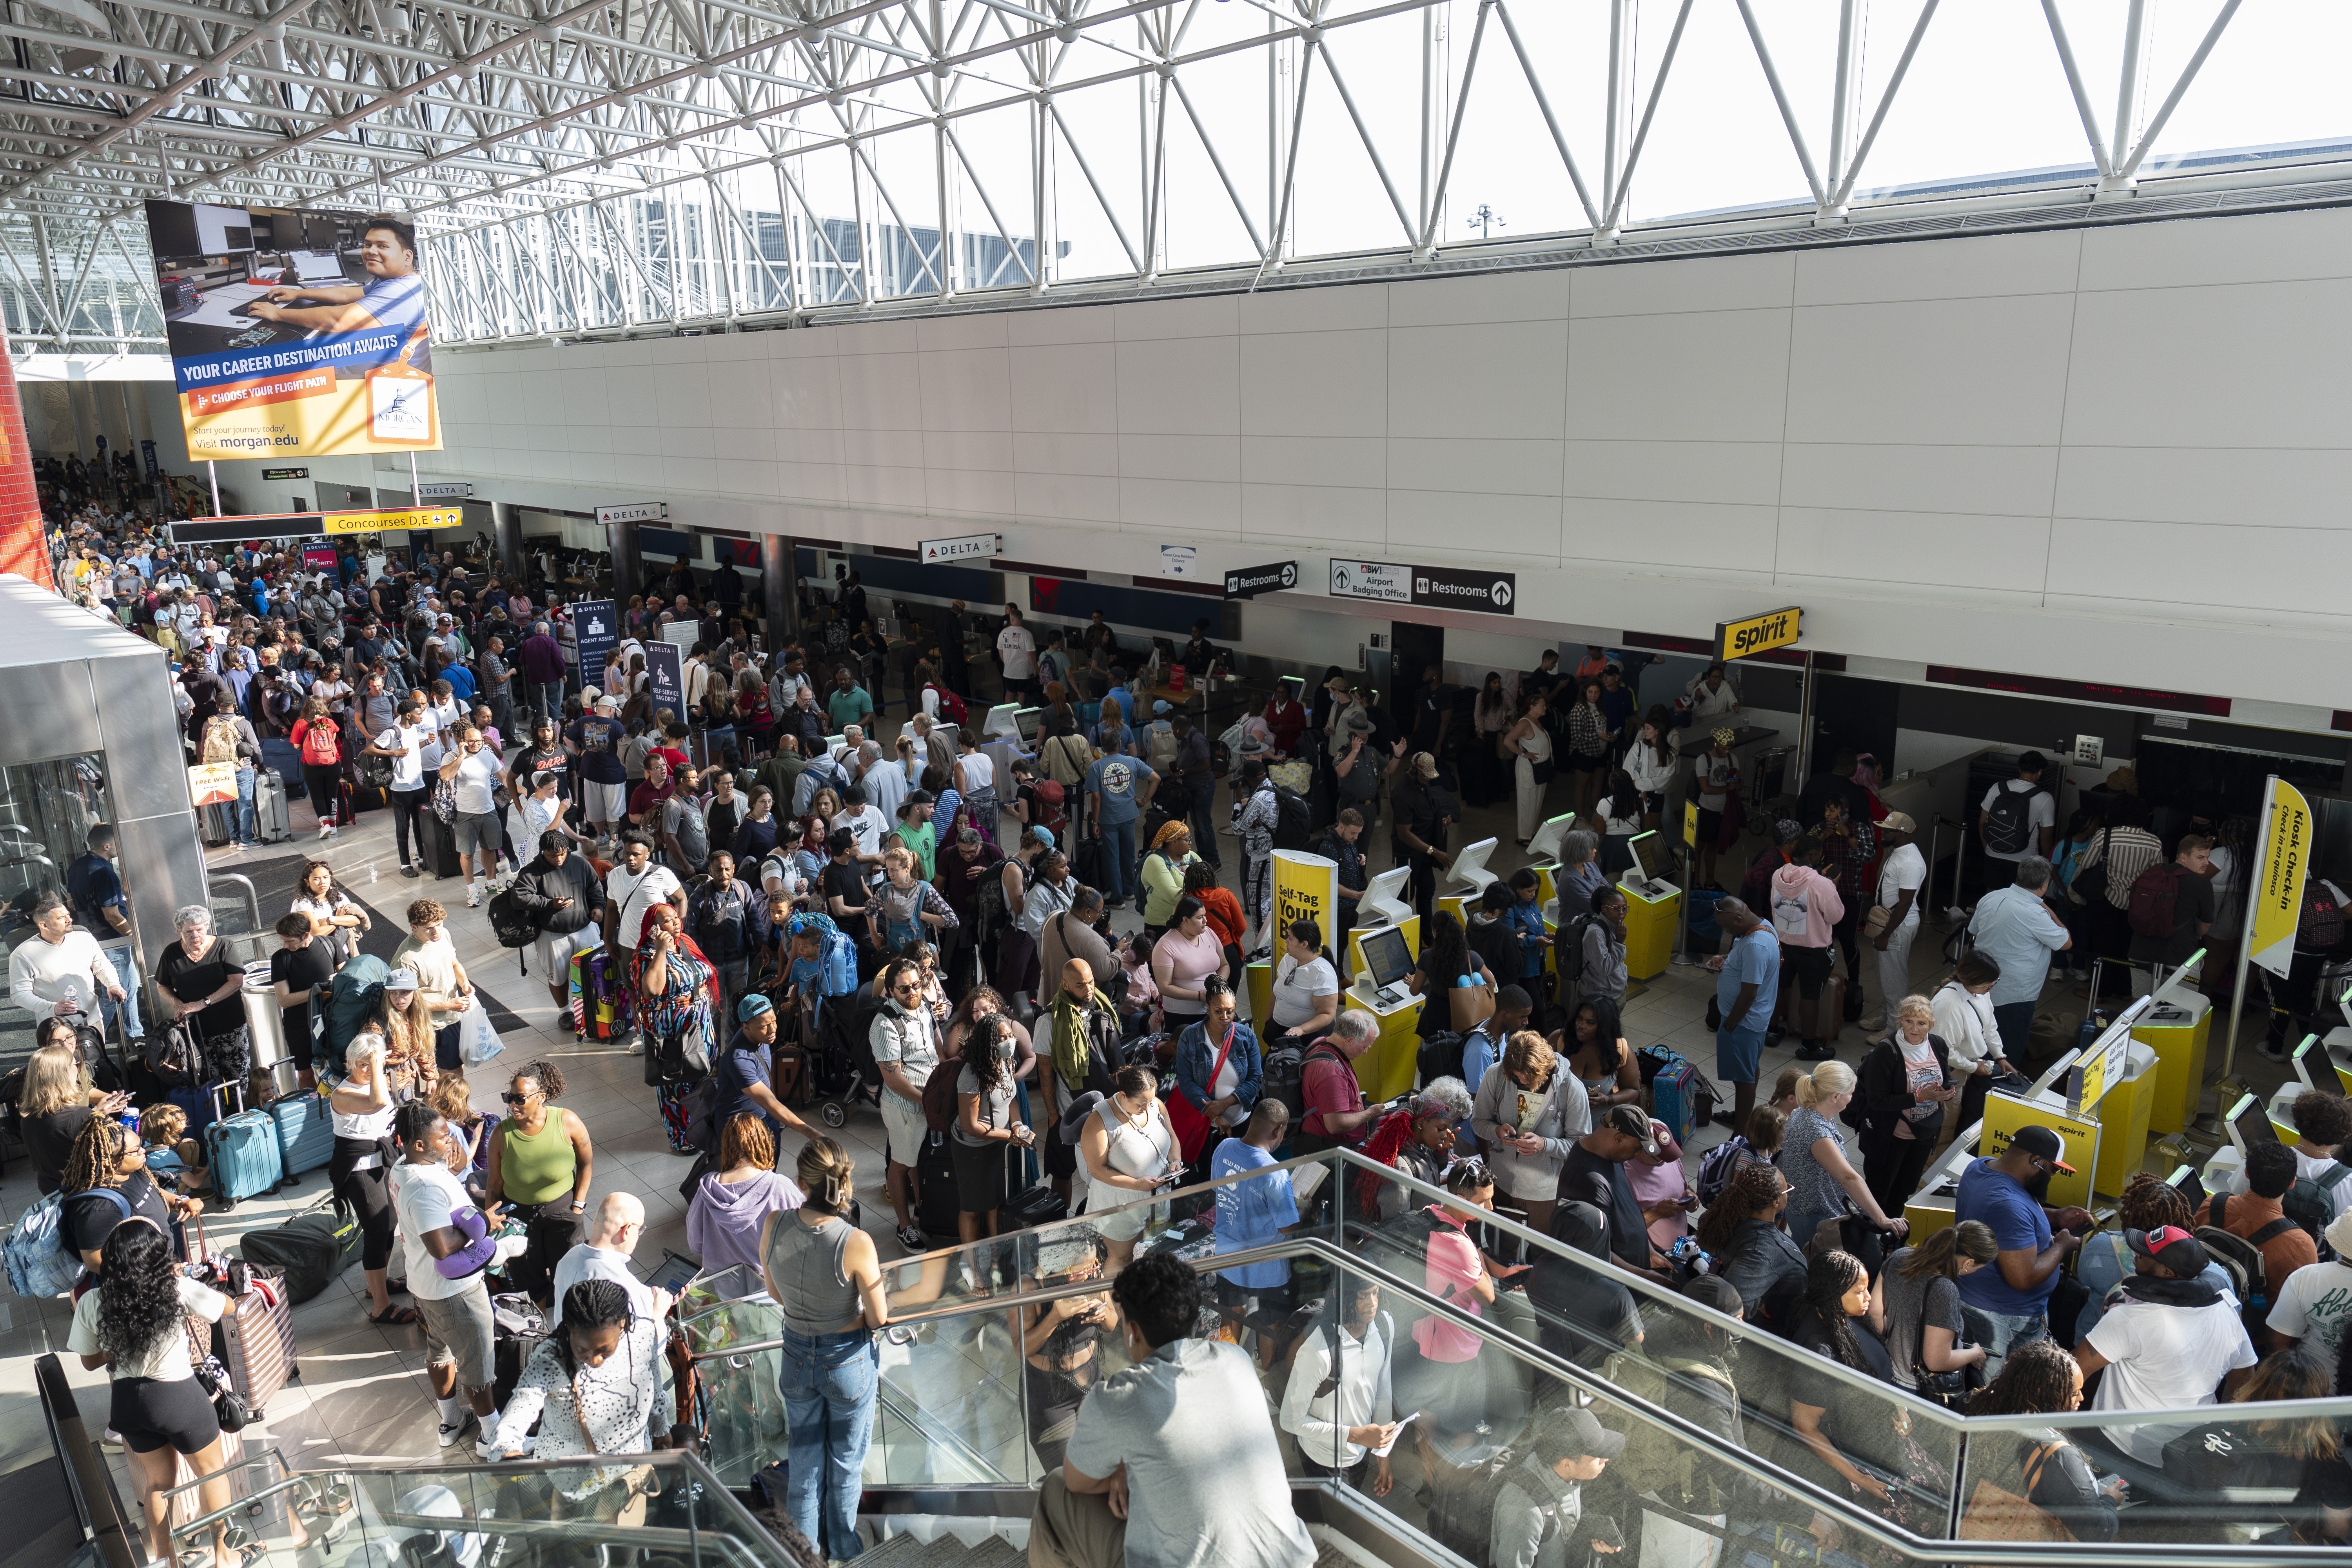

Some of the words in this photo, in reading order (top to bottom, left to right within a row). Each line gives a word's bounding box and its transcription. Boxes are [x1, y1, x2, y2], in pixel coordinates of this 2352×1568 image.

[183, 363, 220, 381] YOUR
[222, 355, 272, 374] CAREER
[275, 342, 351, 366] DESTINATION
[354, 334, 397, 354] AWAITS
[212, 389, 248, 404] CHOOSE
[249, 386, 273, 398] YOUR
[274, 380, 303, 394] FLIGHT
[305, 376, 327, 388] PATH
[232, 426, 261, 435] journey
[263, 425, 285, 434] today!
[196, 439, 216, 448] Visit
[220, 434, 299, 450] morgan.edu
[614, 510, 648, 519] DELTA
[338, 518, 405, 529] Concourses
[942, 543, 980, 555] DELTA
[1367, 565, 1382, 575] BWI
[1240, 574, 1279, 587] Restrooms
[1366, 576, 1393, 588] Airport
[1352, 586, 1383, 598] Badging
[1385, 588, 1407, 599] Office
[1432, 581, 1487, 597] Restrooms
[1734, 615, 1787, 653] spirit
[653, 688, 679, 697] SELF-SERVICE
[1105, 764, 1128, 775] SAVANNAH
[1103, 776, 1118, 785] ROAD
[1119, 774, 1131, 782] TRIP
[2279, 805, 2289, 835] Check
[854, 821, 867, 832] NIKE
[2290, 810, 2303, 850] Kiosk
[2278, 835, 2285, 845] in
[2276, 846, 2282, 859] en
[2269, 859, 2280, 897] quiosco
[2280, 851, 2297, 910] Check-in
[1279, 884, 1318, 907] Self-Tag
[1279, 896, 1320, 922] Your
[1371, 954, 1385, 962] Space
[2273, 967, 2286, 976] spirit
[2184, 975, 2200, 984] spirit
[2271, 1006, 2290, 1015] spirit
[2109, 1048, 2124, 1067] Boarding
[2058, 1125, 2086, 1138] spirit
[1223, 1158, 1234, 1167] VALLEY
